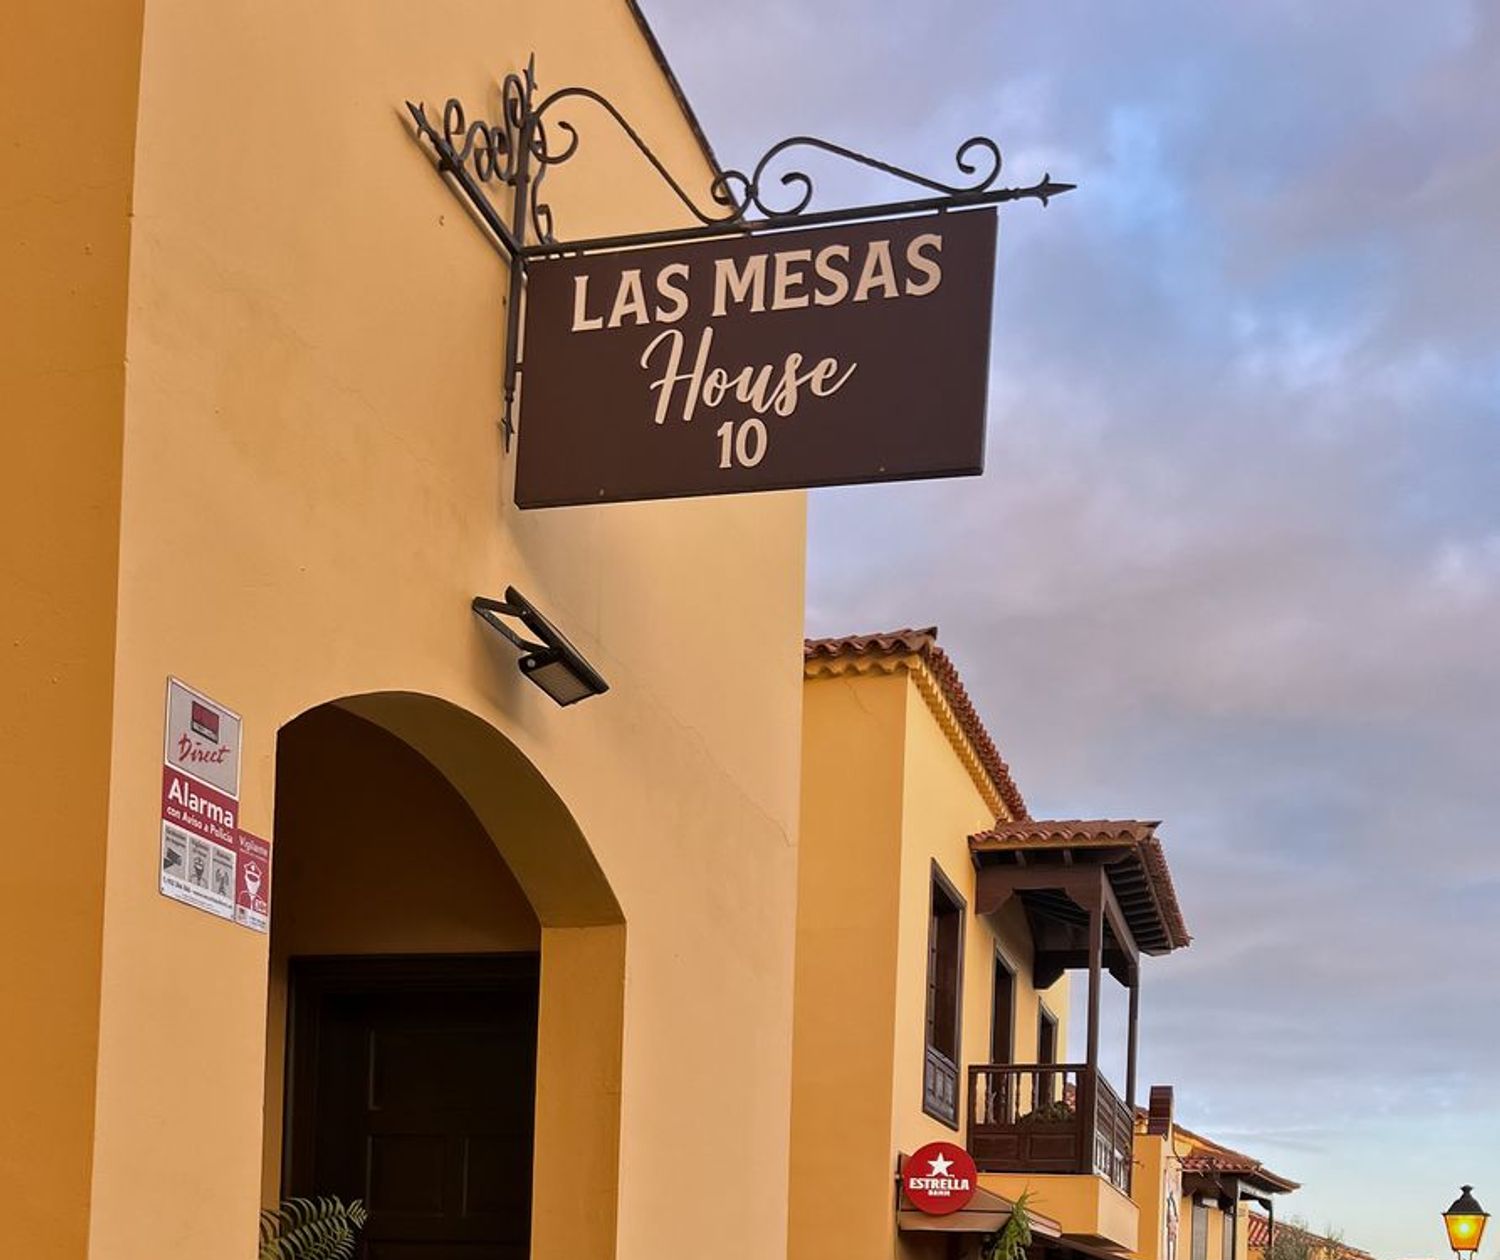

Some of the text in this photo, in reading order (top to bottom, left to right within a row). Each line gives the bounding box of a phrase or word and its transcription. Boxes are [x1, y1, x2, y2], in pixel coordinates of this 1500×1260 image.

[572, 234, 944, 332] LAS MESAS
[640, 326, 857, 424] House
[717, 418, 768, 469] 10
[178, 733, 230, 763] Direct
[168, 778, 234, 828] Alarma
[909, 1177, 969, 1190] ESTRELLA
